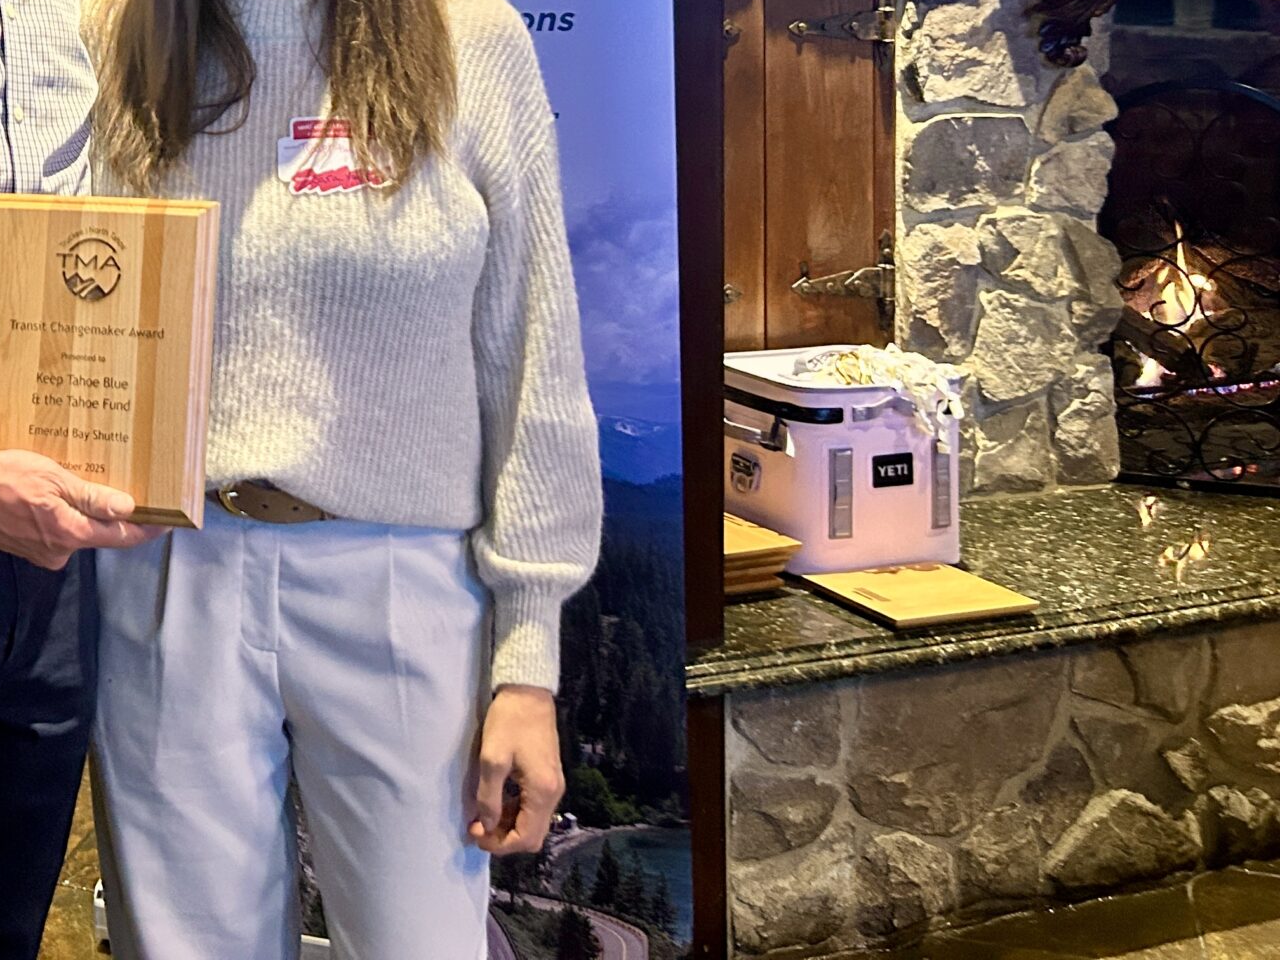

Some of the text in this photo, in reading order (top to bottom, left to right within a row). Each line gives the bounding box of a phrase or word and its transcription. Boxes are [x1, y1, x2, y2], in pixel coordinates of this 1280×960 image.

[56, 252, 121, 271] TMA
[10, 318, 165, 340] Transit Changemaker Award
[36, 372, 129, 390] Keep Tahoe Blue
[44, 393, 63, 406] the
[67, 395, 100, 409] Tahoe
[103, 398, 131, 412] Fund
[28, 424, 129, 443] Emerald Bay Shuttle
[85, 462, 105, 474] 2025
[877, 463, 909, 478] YETI
